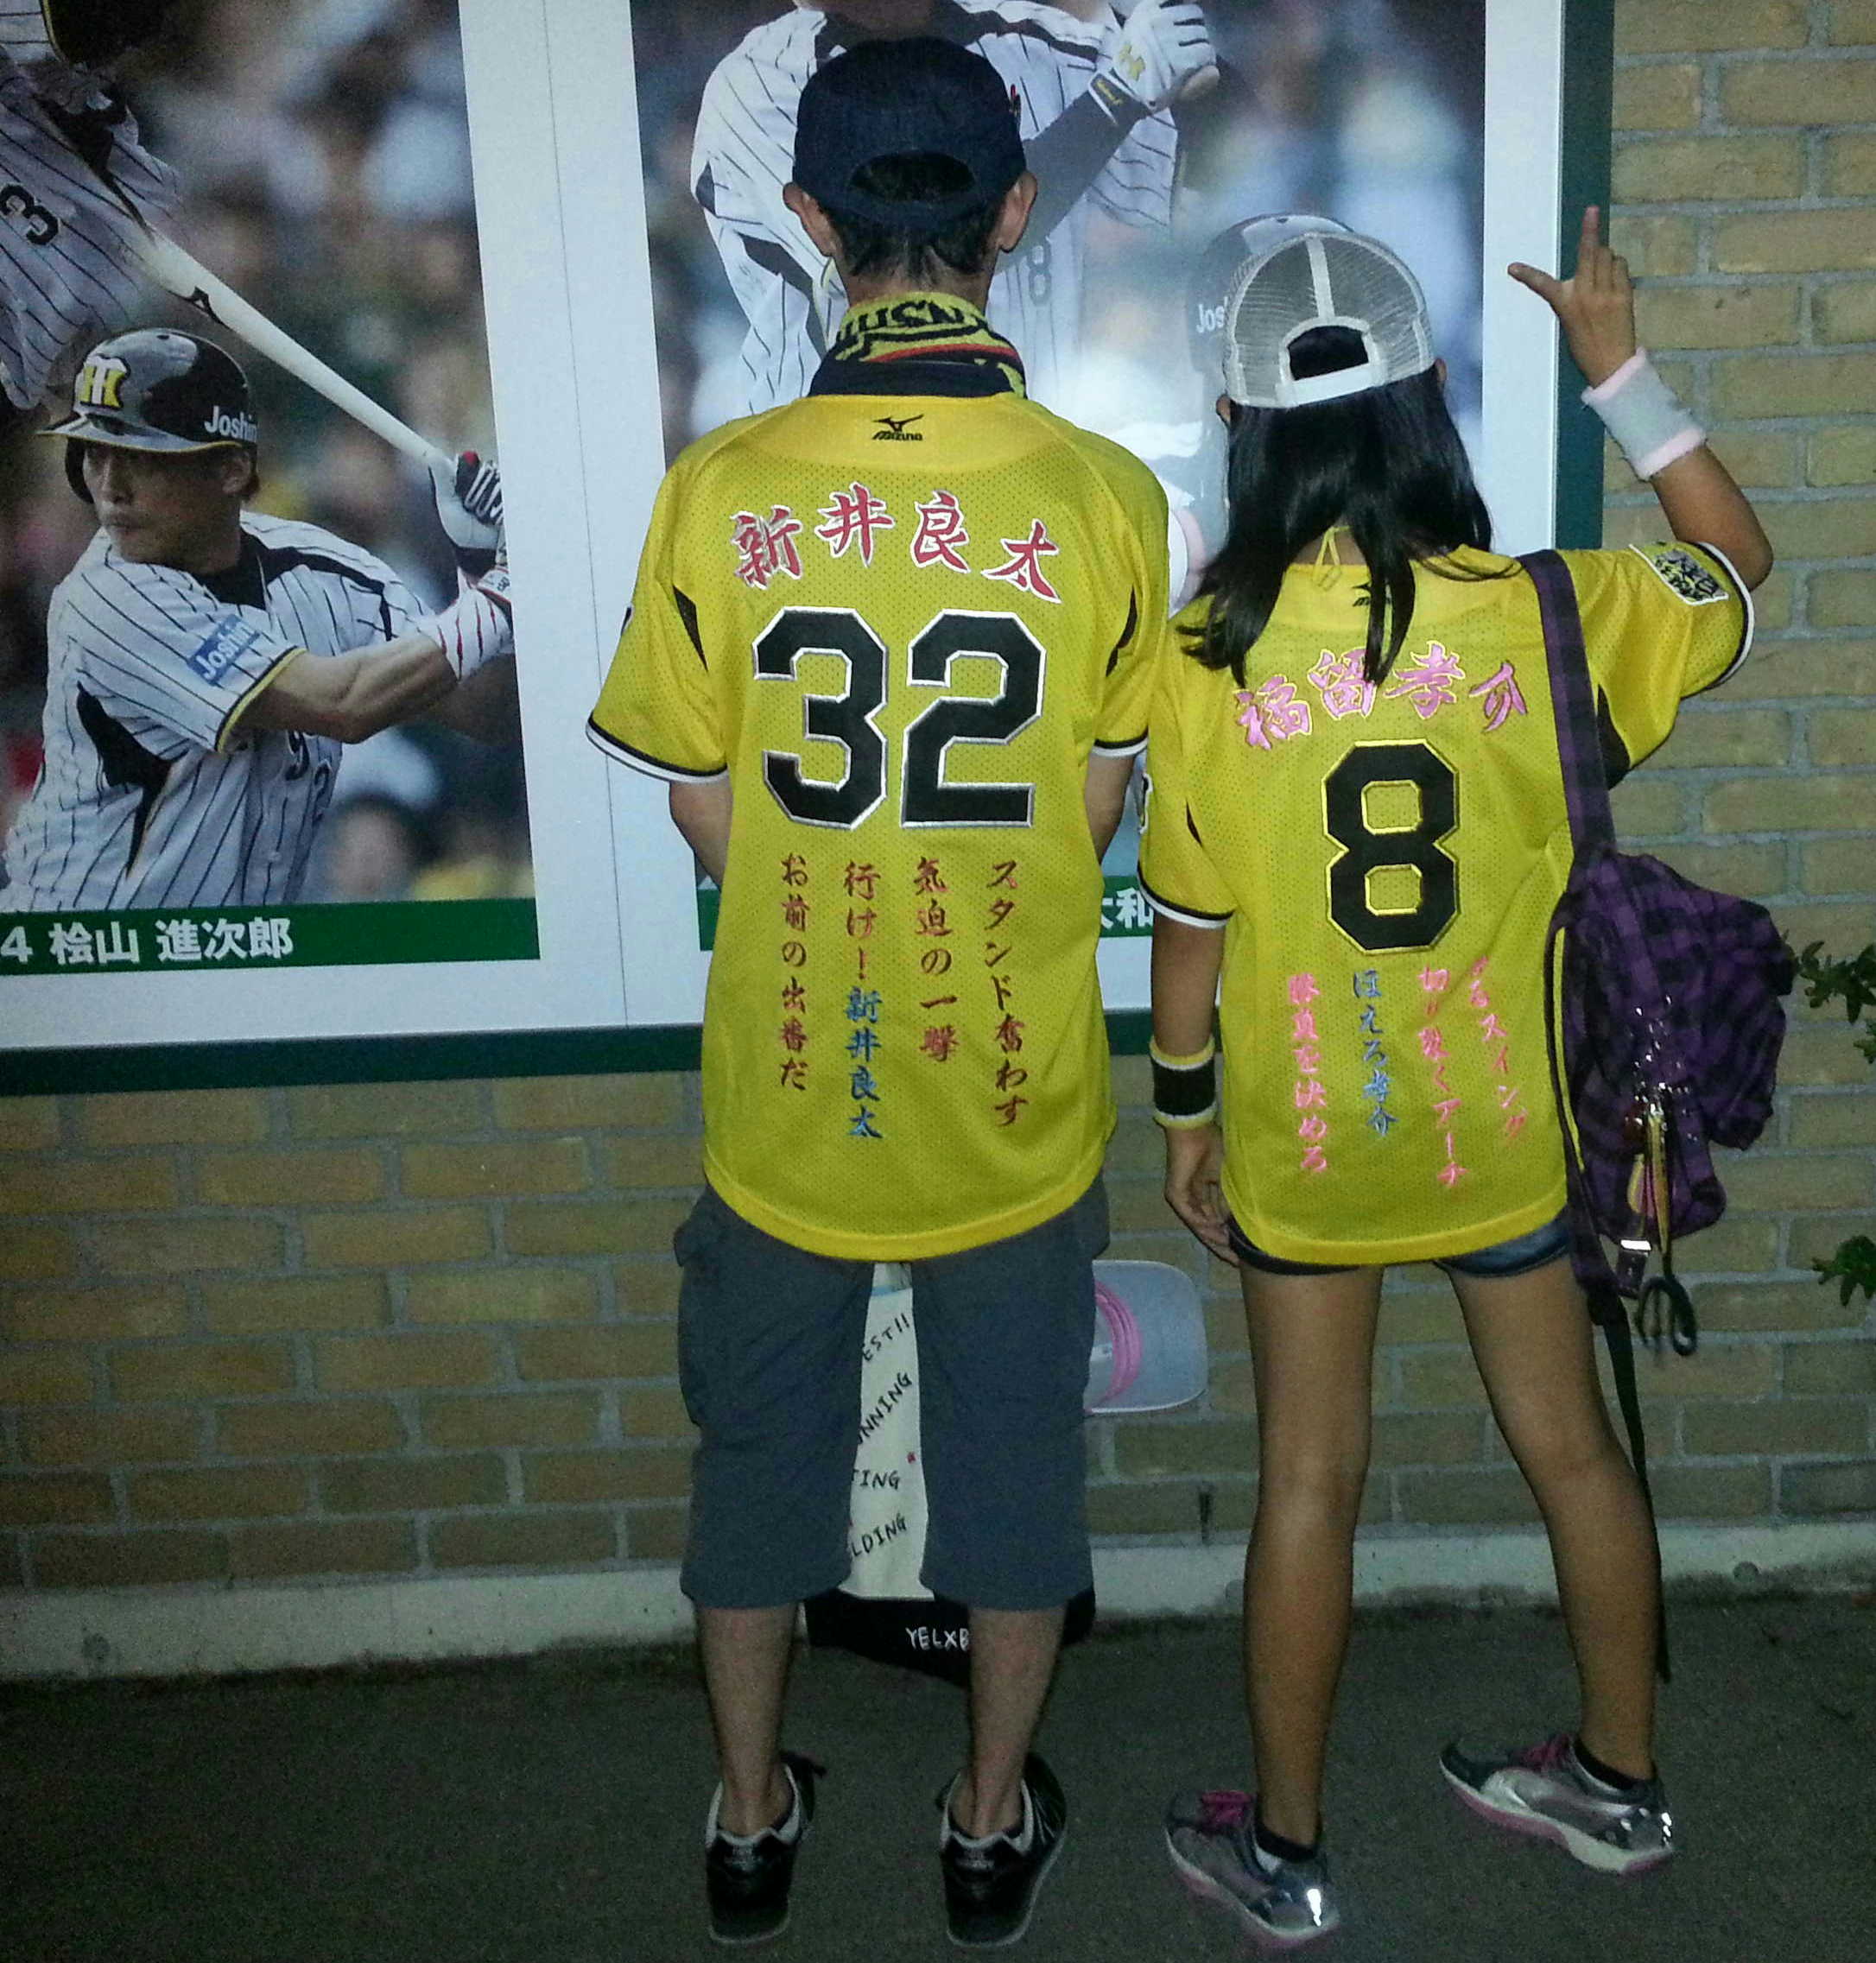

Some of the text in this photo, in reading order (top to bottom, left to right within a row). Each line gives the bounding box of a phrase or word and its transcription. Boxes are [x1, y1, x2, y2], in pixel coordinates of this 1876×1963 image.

[1195, 296, 1228, 333] Jos
[731, 481, 1062, 604] 新井良太
[752, 605, 1046, 830] 32
[1233, 641, 1528, 750] 福留孝介
[1321, 738, 1460, 956] 8
[0, 915, 295, 966] 4 桧山 進次郎
[780, 852, 809, 1091] お前の出番だ
[913, 856, 959, 1062] 気迫の一撃
[1353, 969, 1400, 1137] ほえろ孝介
